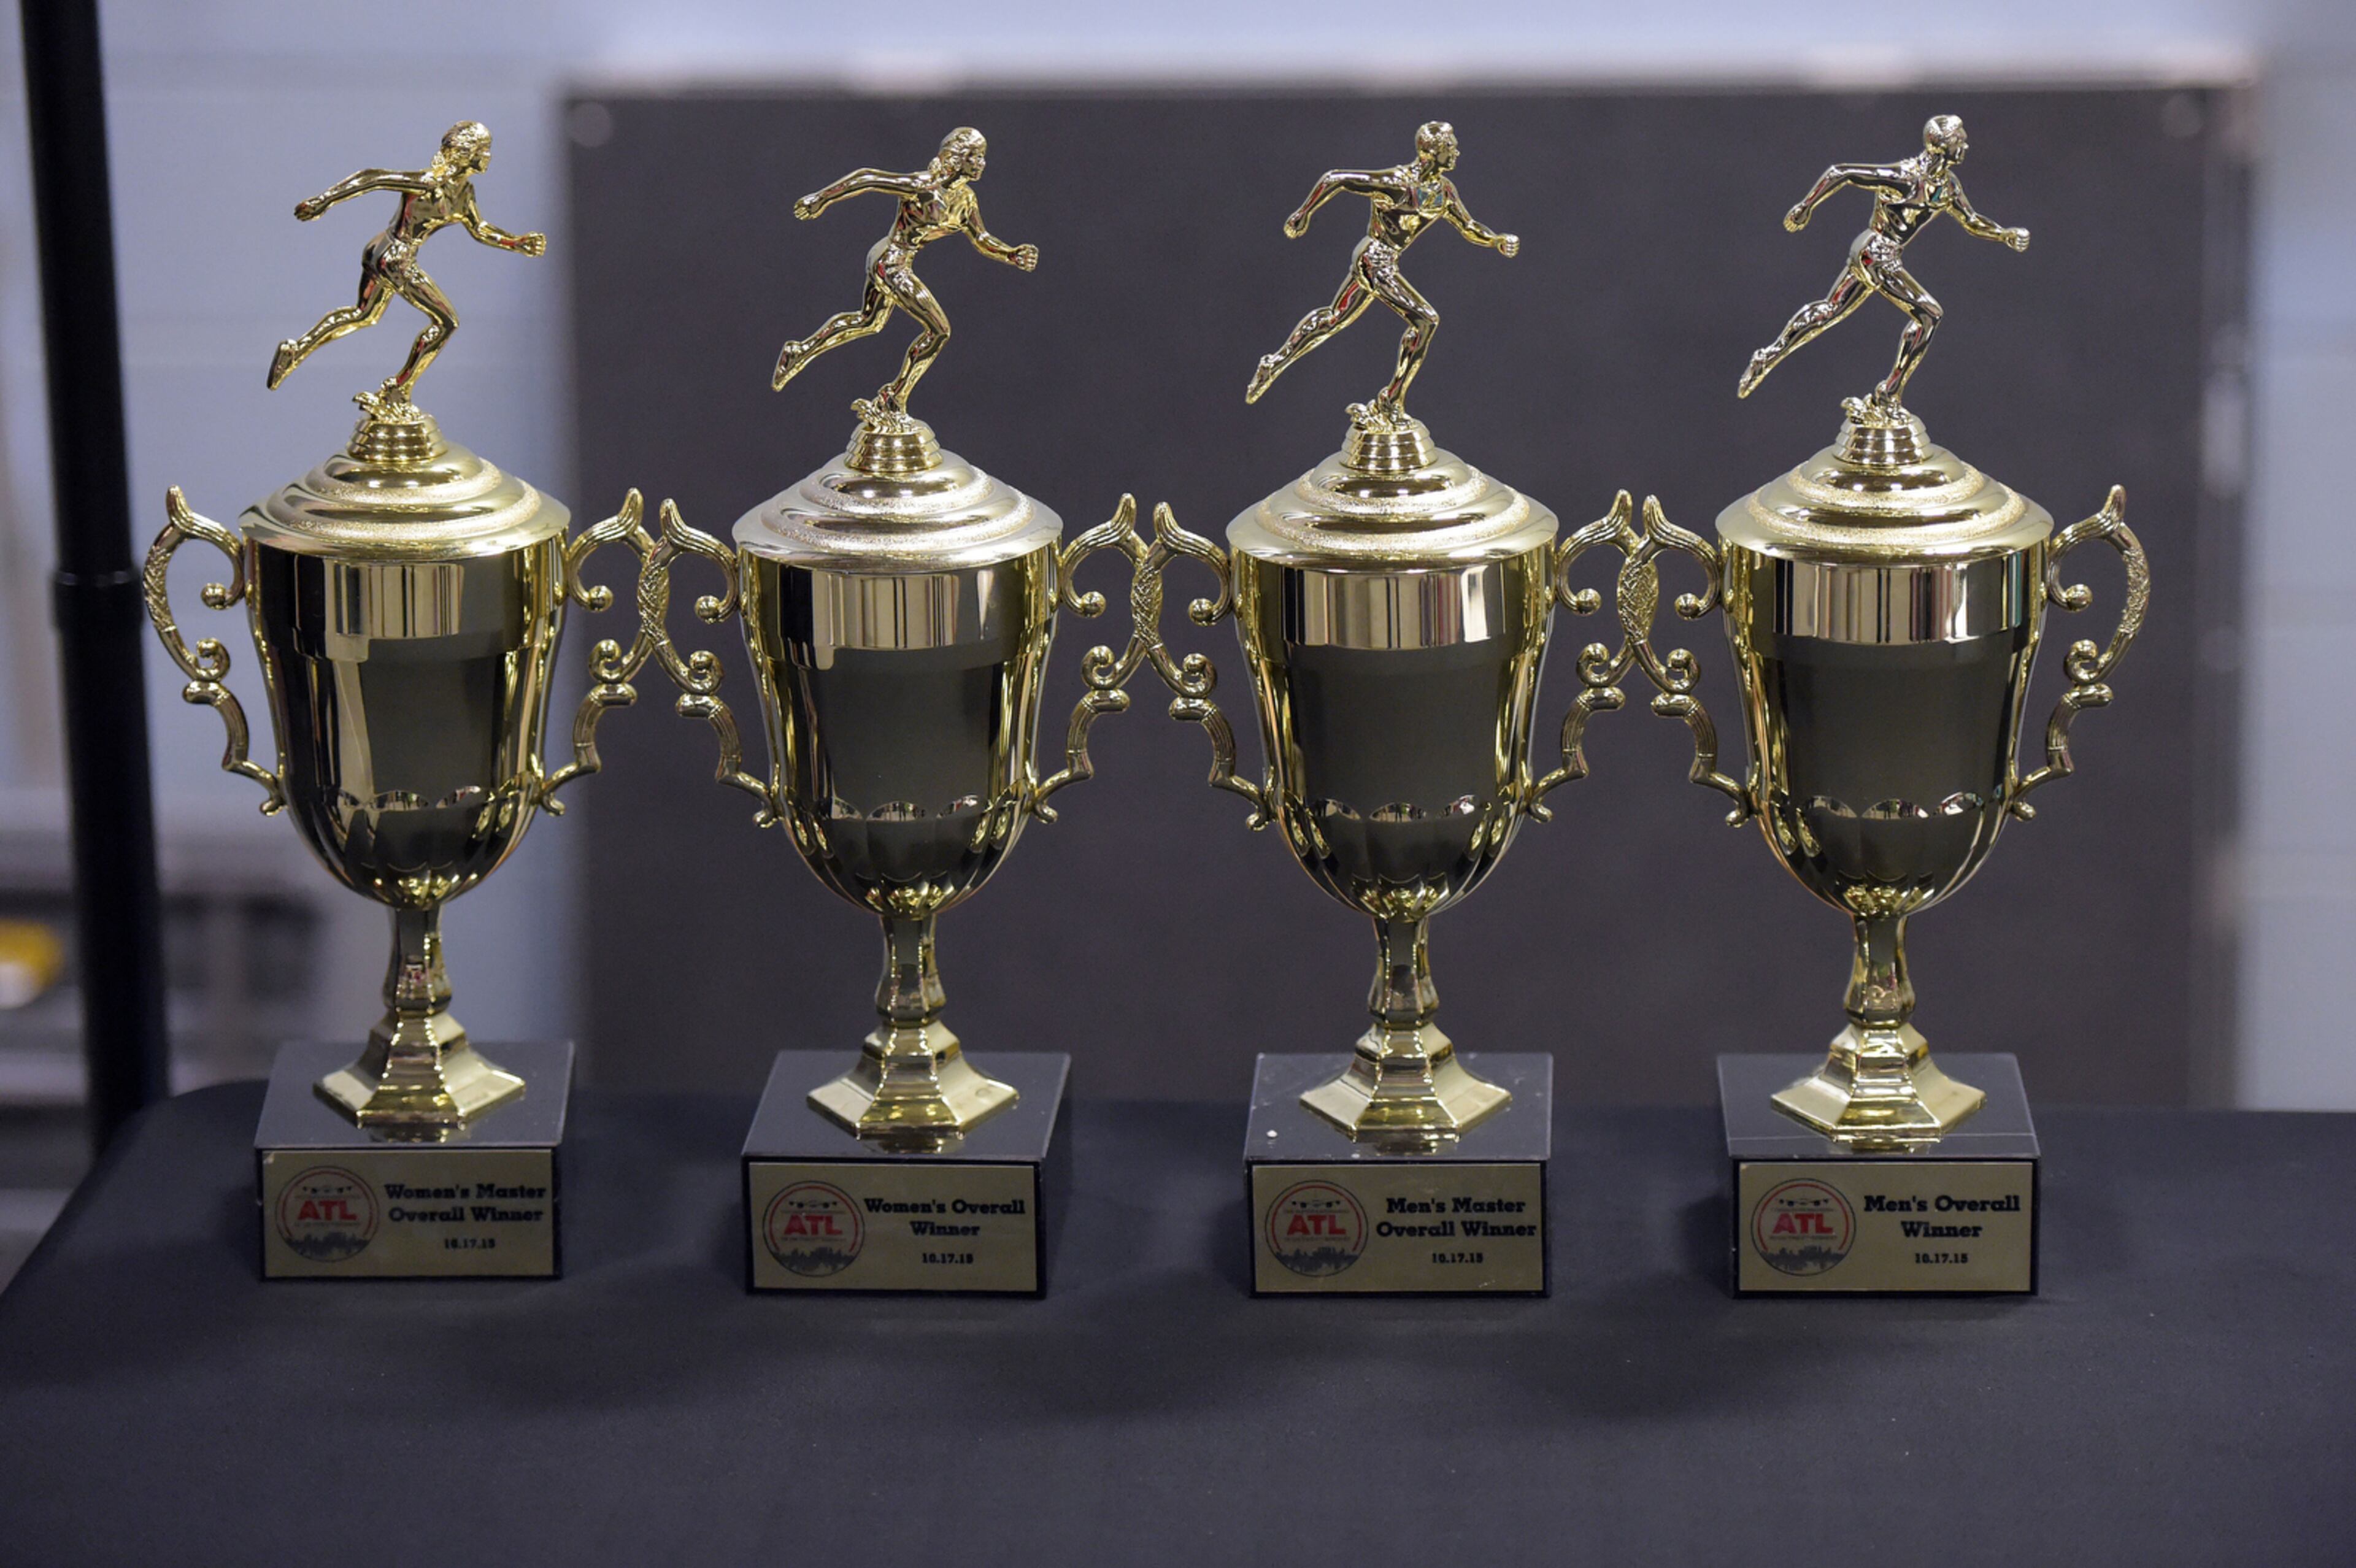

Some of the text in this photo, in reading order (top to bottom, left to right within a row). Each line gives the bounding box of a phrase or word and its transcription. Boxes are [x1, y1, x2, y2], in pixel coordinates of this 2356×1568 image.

[384, 1183, 547, 1199] Women's Master
[297, 1199, 359, 1221] ATL
[863, 1198, 1026, 1215] Women's Overall
[1386, 1197, 1526, 1213] Men's Master
[1864, 1194, 2020, 1212] Men's Overall
[388, 1206, 544, 1222] Overall Winner
[783, 1213, 842, 1236] ATL
[909, 1220, 980, 1236] Winner
[1287, 1213, 1346, 1236] ATL
[1376, 1220, 1537, 1237] Overall Winner
[1772, 1212, 1833, 1234] ATL
[1900, 1221, 1982, 1238] Winner
